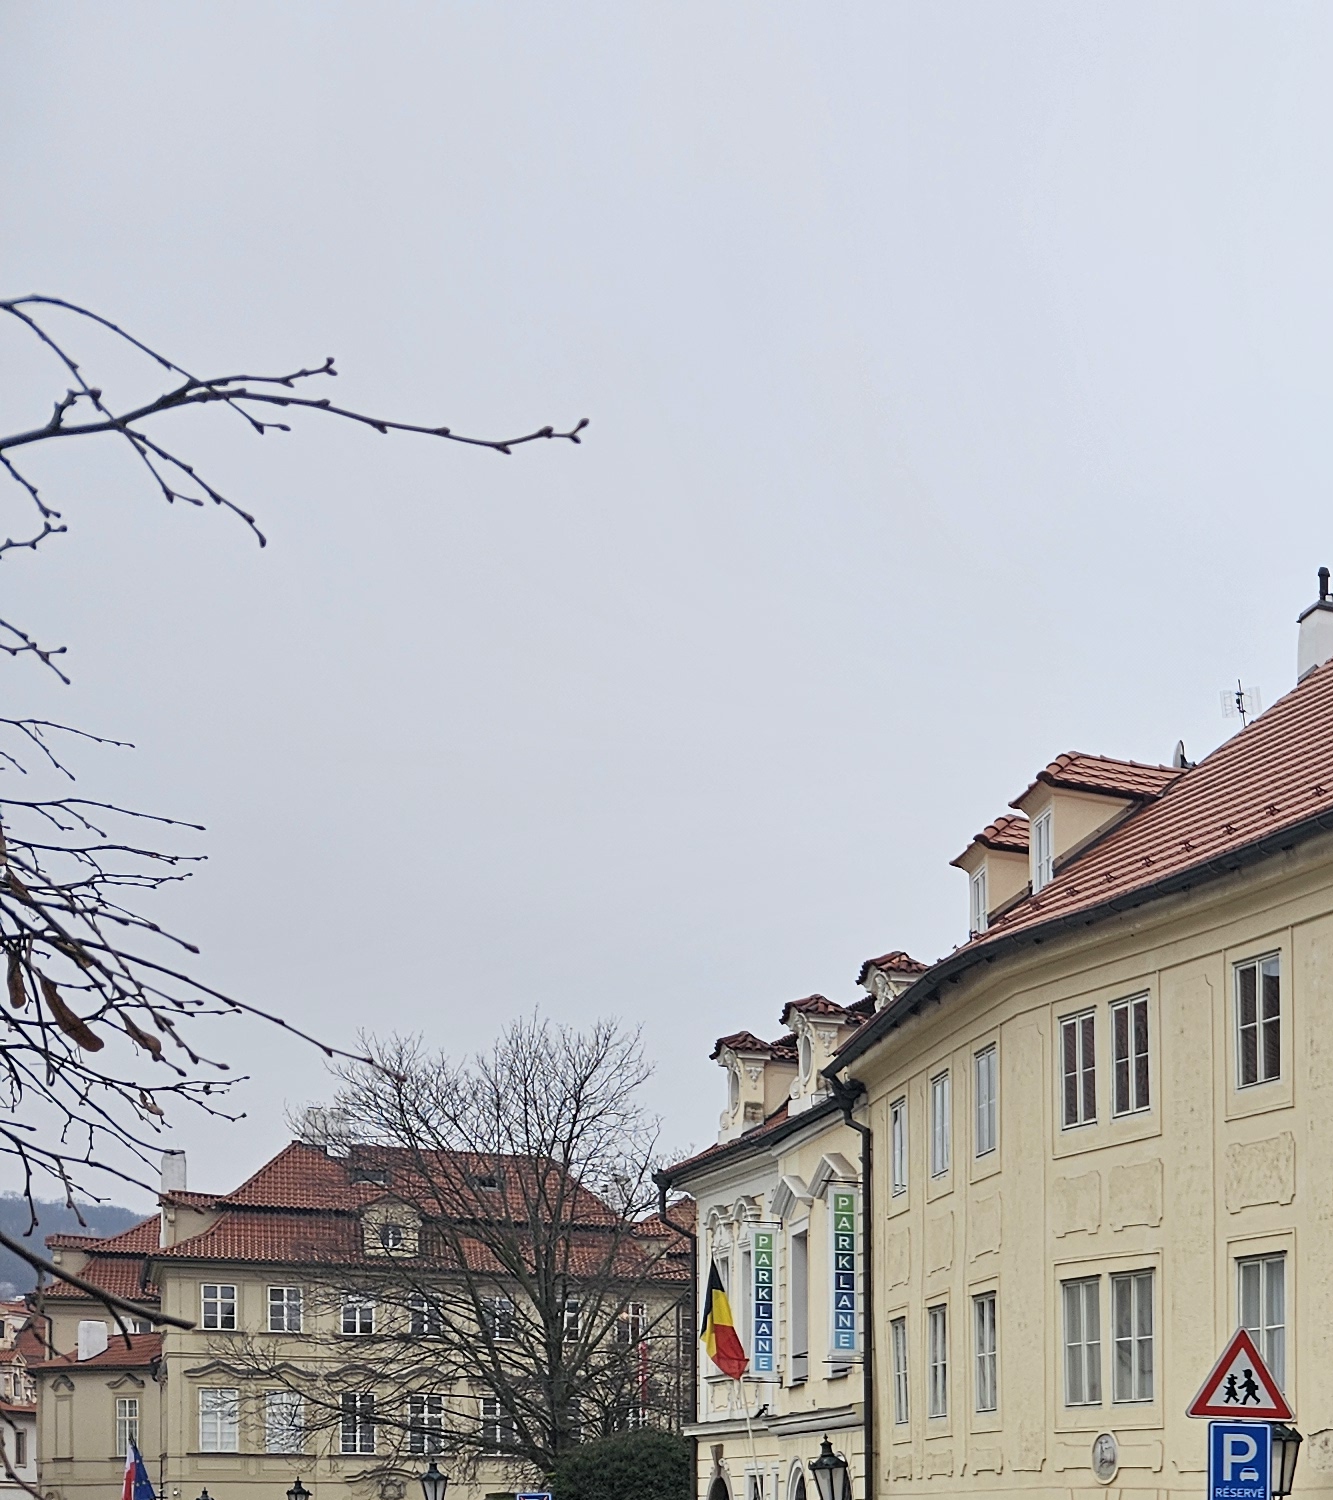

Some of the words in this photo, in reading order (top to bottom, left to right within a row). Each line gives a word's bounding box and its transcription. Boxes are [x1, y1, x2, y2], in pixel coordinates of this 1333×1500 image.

[758, 1236, 770, 1369] PARKLANE
[838, 1197, 852, 1347] PARKLANE
[1215, 1485, 1265, 1499] RÉSERVÉ
[1223, 1433, 1258, 1482] P
